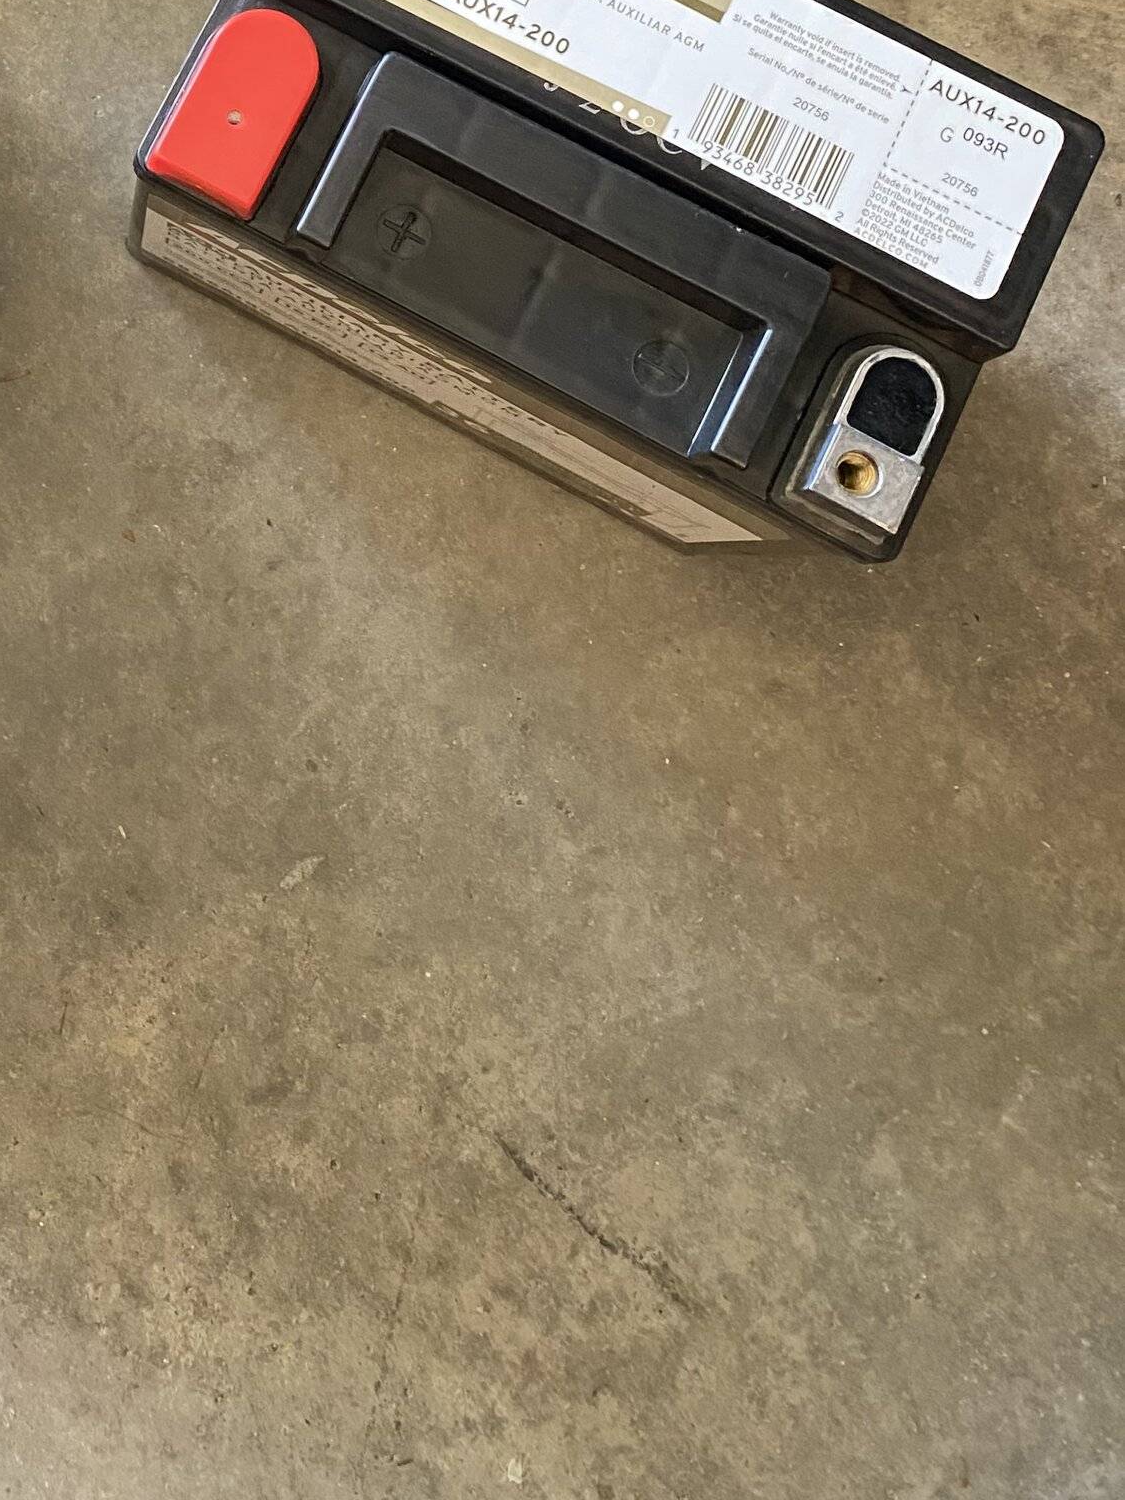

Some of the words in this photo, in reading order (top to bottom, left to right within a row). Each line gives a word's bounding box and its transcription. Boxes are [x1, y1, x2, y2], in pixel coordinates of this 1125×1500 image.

[673, 30, 705, 53] AGM
[732, 13, 742, 23] Si
[741, 19, 752, 28] se
[751, 24, 774, 40] quita
[773, 34, 783, 43] el
[815, 55, 827, 65] se
[825, 60, 850, 77] anula
[752, 13, 788, 36] Garantie
[787, 31, 809, 46] nulle
[808, 41, 817, 50] si
[768, 11, 807, 36] Warranty
[805, 30, 825, 44] void
[823, 39, 831, 47] if
[831, 43, 856, 60] insert
[855, 54, 864, 64] is
[863, 59, 902, 83] removed.
[747, 46, 774, 65] Serial
[804, 76, 817, 87] de
[855, 100, 868, 112] de
[867, 107, 890, 124] serie
[792, 95, 831, 121] 20756
[928, 77, 1047, 146] AUX14-200
[938, 125, 956, 143] G
[960, 126, 1010, 160] 093R
[670, 127, 680, 139] 1
[699, 139, 757, 177] 93468
[758, 169, 816, 207] 38295
[833, 209, 845, 222] 2
[876, 172, 902, 189] Made
[901, 184, 912, 195] in
[911, 189, 951, 214] Vietnam
[940, 171, 980, 198] 20756
[863, 198, 900, 222] Detroit,
[899, 216, 912, 228] MI
[911, 222, 944, 244] 48265
[868, 189, 889, 205] 300
[887, 199, 945, 234] Renaissance
[944, 228, 977, 250] Center
[872, 180, 923, 211] Distributed
[921, 206, 935, 219] by
[934, 212, 975, 238] ACDelco
[852, 226, 929, 269] ACDELCO.COM
[856, 216, 870, 228] All
[868, 223, 897, 244] Rights
[897, 237, 940, 265] Reserved
[893, 224, 910, 238] GM
[908, 232, 928, 247] LLC
